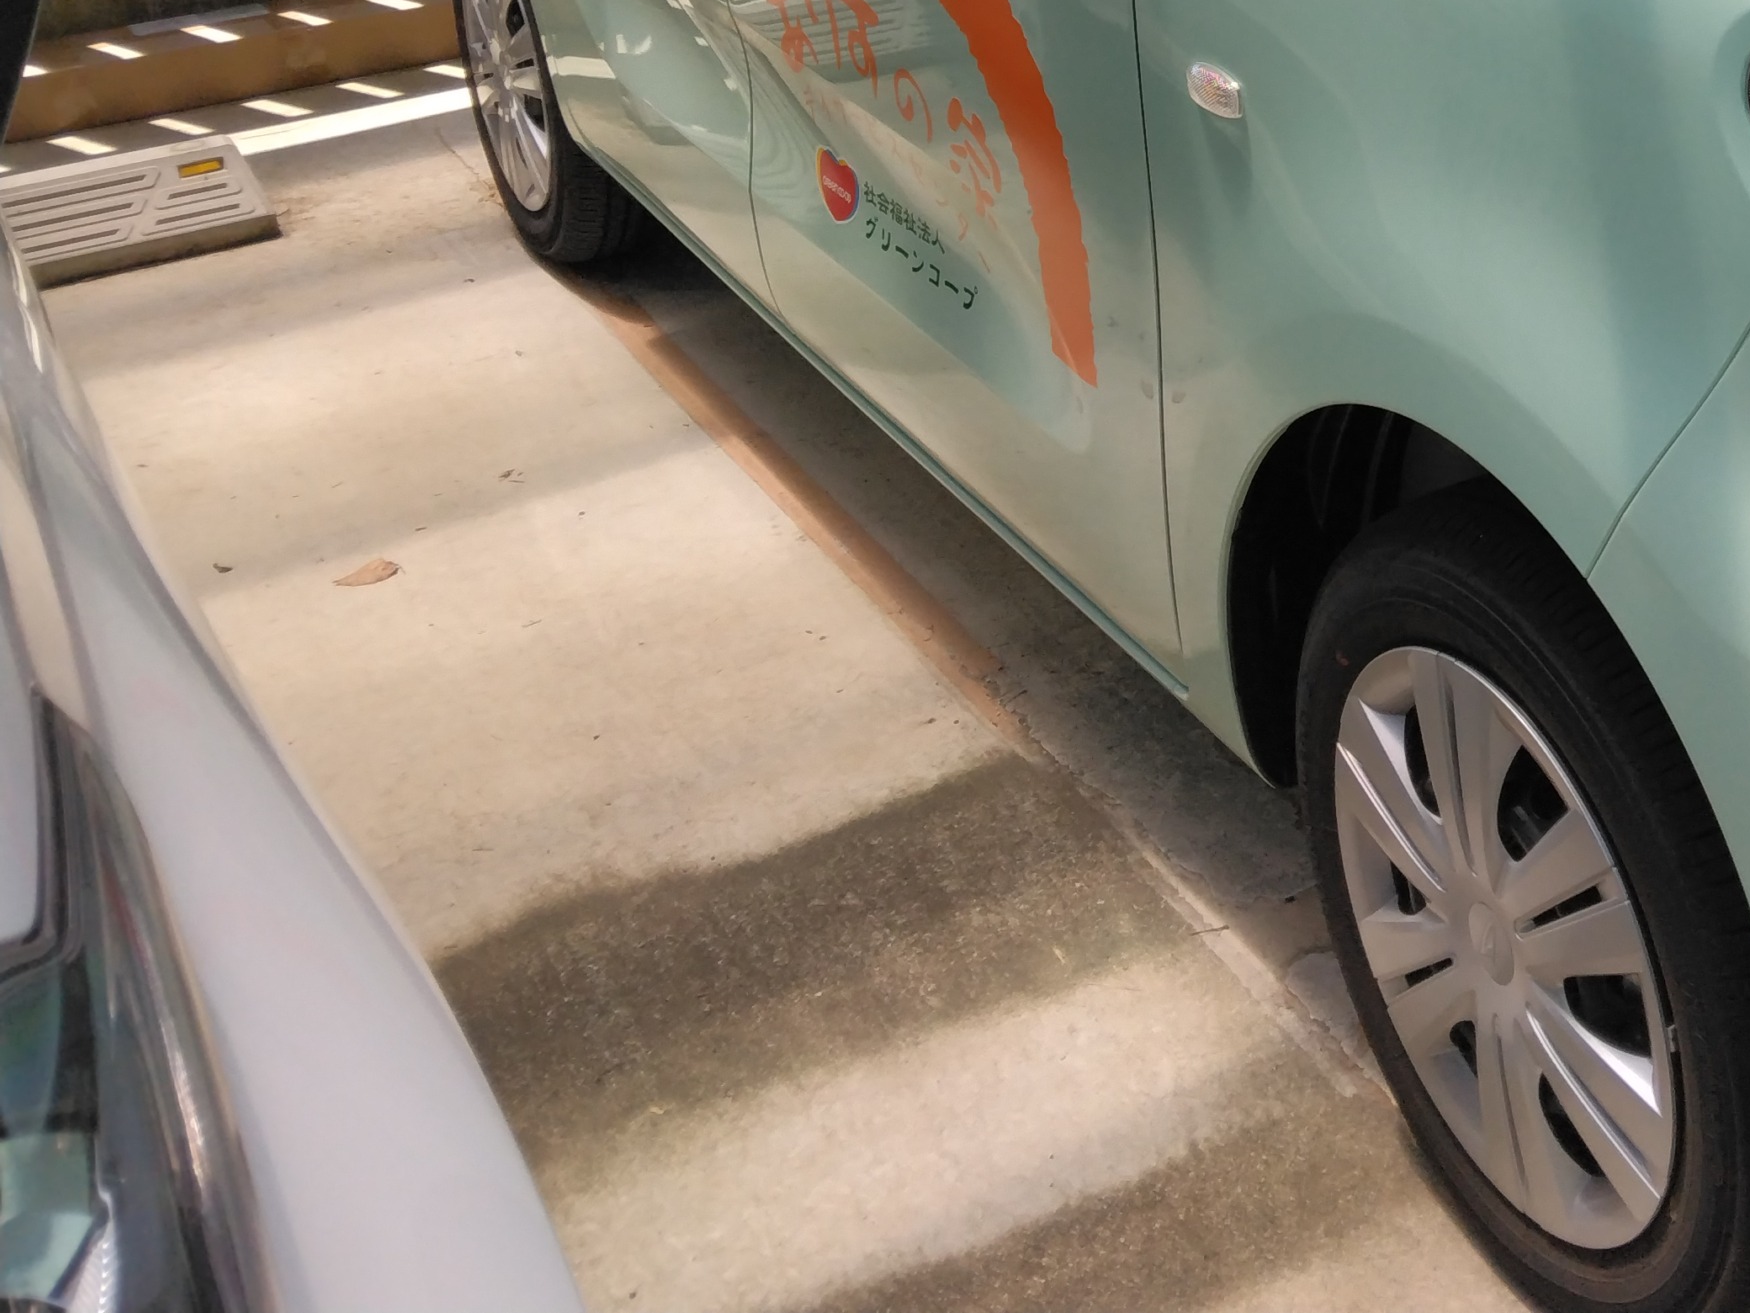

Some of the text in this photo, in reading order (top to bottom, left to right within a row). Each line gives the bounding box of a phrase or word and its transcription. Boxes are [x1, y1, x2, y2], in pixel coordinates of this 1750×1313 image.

[863, 181, 946, 255] 社会福祉法人
[865, 217, 978, 310] グリーンコープ
